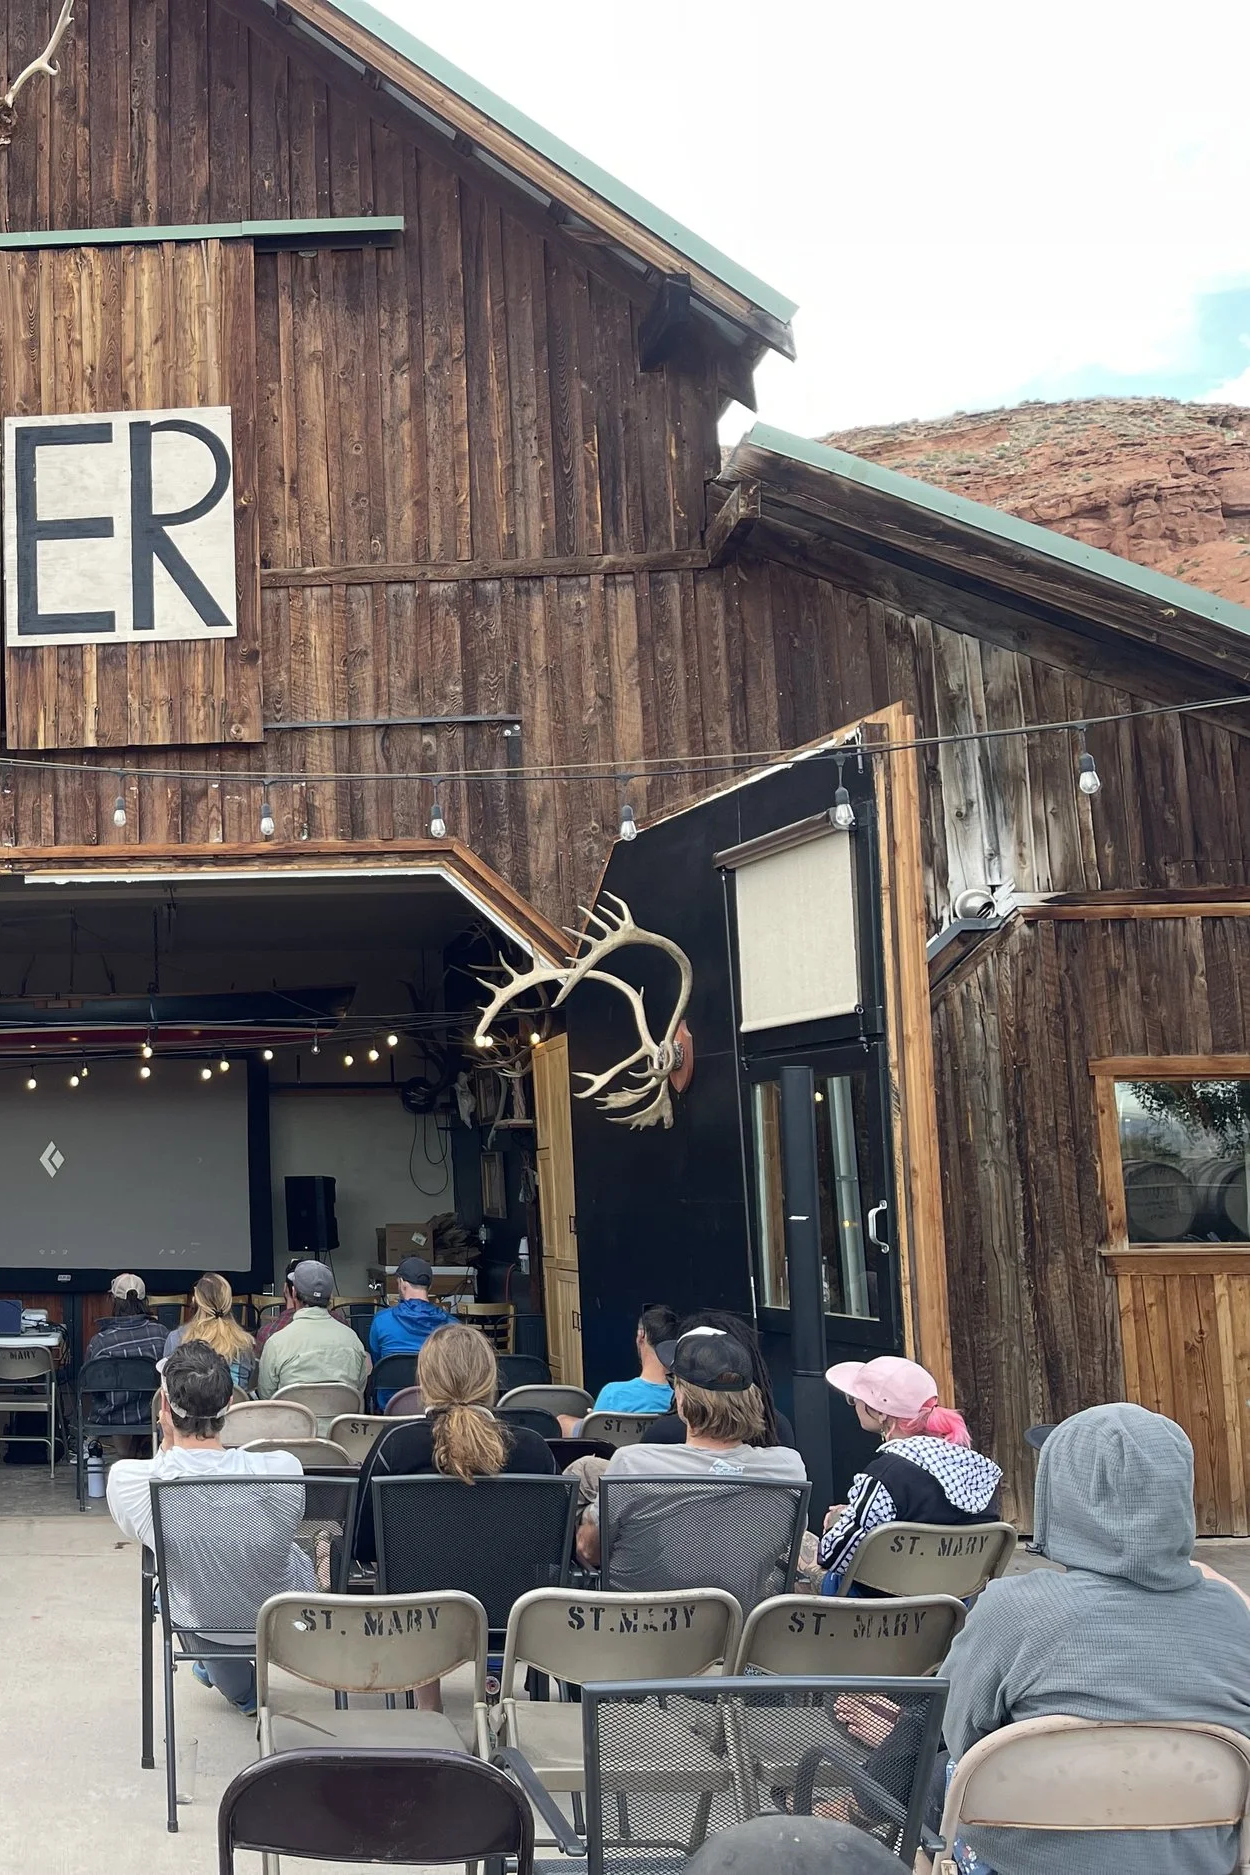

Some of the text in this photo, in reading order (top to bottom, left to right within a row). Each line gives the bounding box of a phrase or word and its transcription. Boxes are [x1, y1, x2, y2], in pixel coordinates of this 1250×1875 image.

[10, 1350, 36, 1360] MARY
[350, 1422, 374, 1436] ST.
[604, 1419, 627, 1433] ST.
[890, 1535, 990, 1557] ST. MARY
[300, 1606, 441, 1636] ST. MARY
[788, 1611, 927, 1638] ST. MARY
